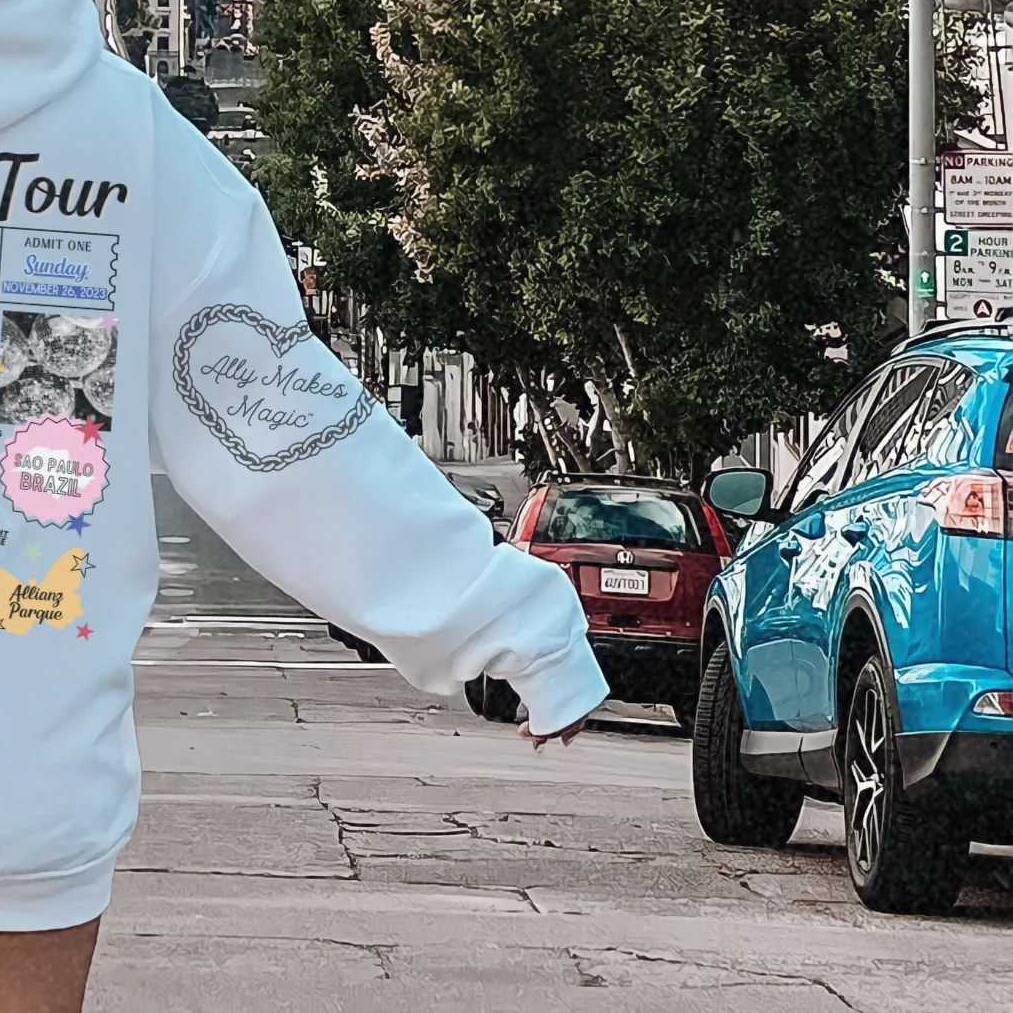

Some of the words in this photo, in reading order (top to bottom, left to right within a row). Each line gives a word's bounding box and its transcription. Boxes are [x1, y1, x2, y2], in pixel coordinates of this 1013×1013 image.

[944, 156, 963, 166] NO
[985, 176, 1012, 185] 10AM
[24, 237, 64, 250] ADMIT
[68, 240, 92, 252] ONE
[950, 234, 962, 252] 2
[970, 248, 1013, 258] PARKIN
[2, 281, 60, 295] NOVEMBER
[62, 286, 76, 298] 26,
[80, 287, 106, 299] 2023
[201, 355, 258, 388] Ally
[262, 365, 348, 398] Makes
[14, 454, 43, 470] SAO
[47, 458, 94, 477] PAULO
[20, 472, 82, 498] BRAZIL
[9, 585, 64, 607] Allianz
[9, 601, 63, 624] Parque
